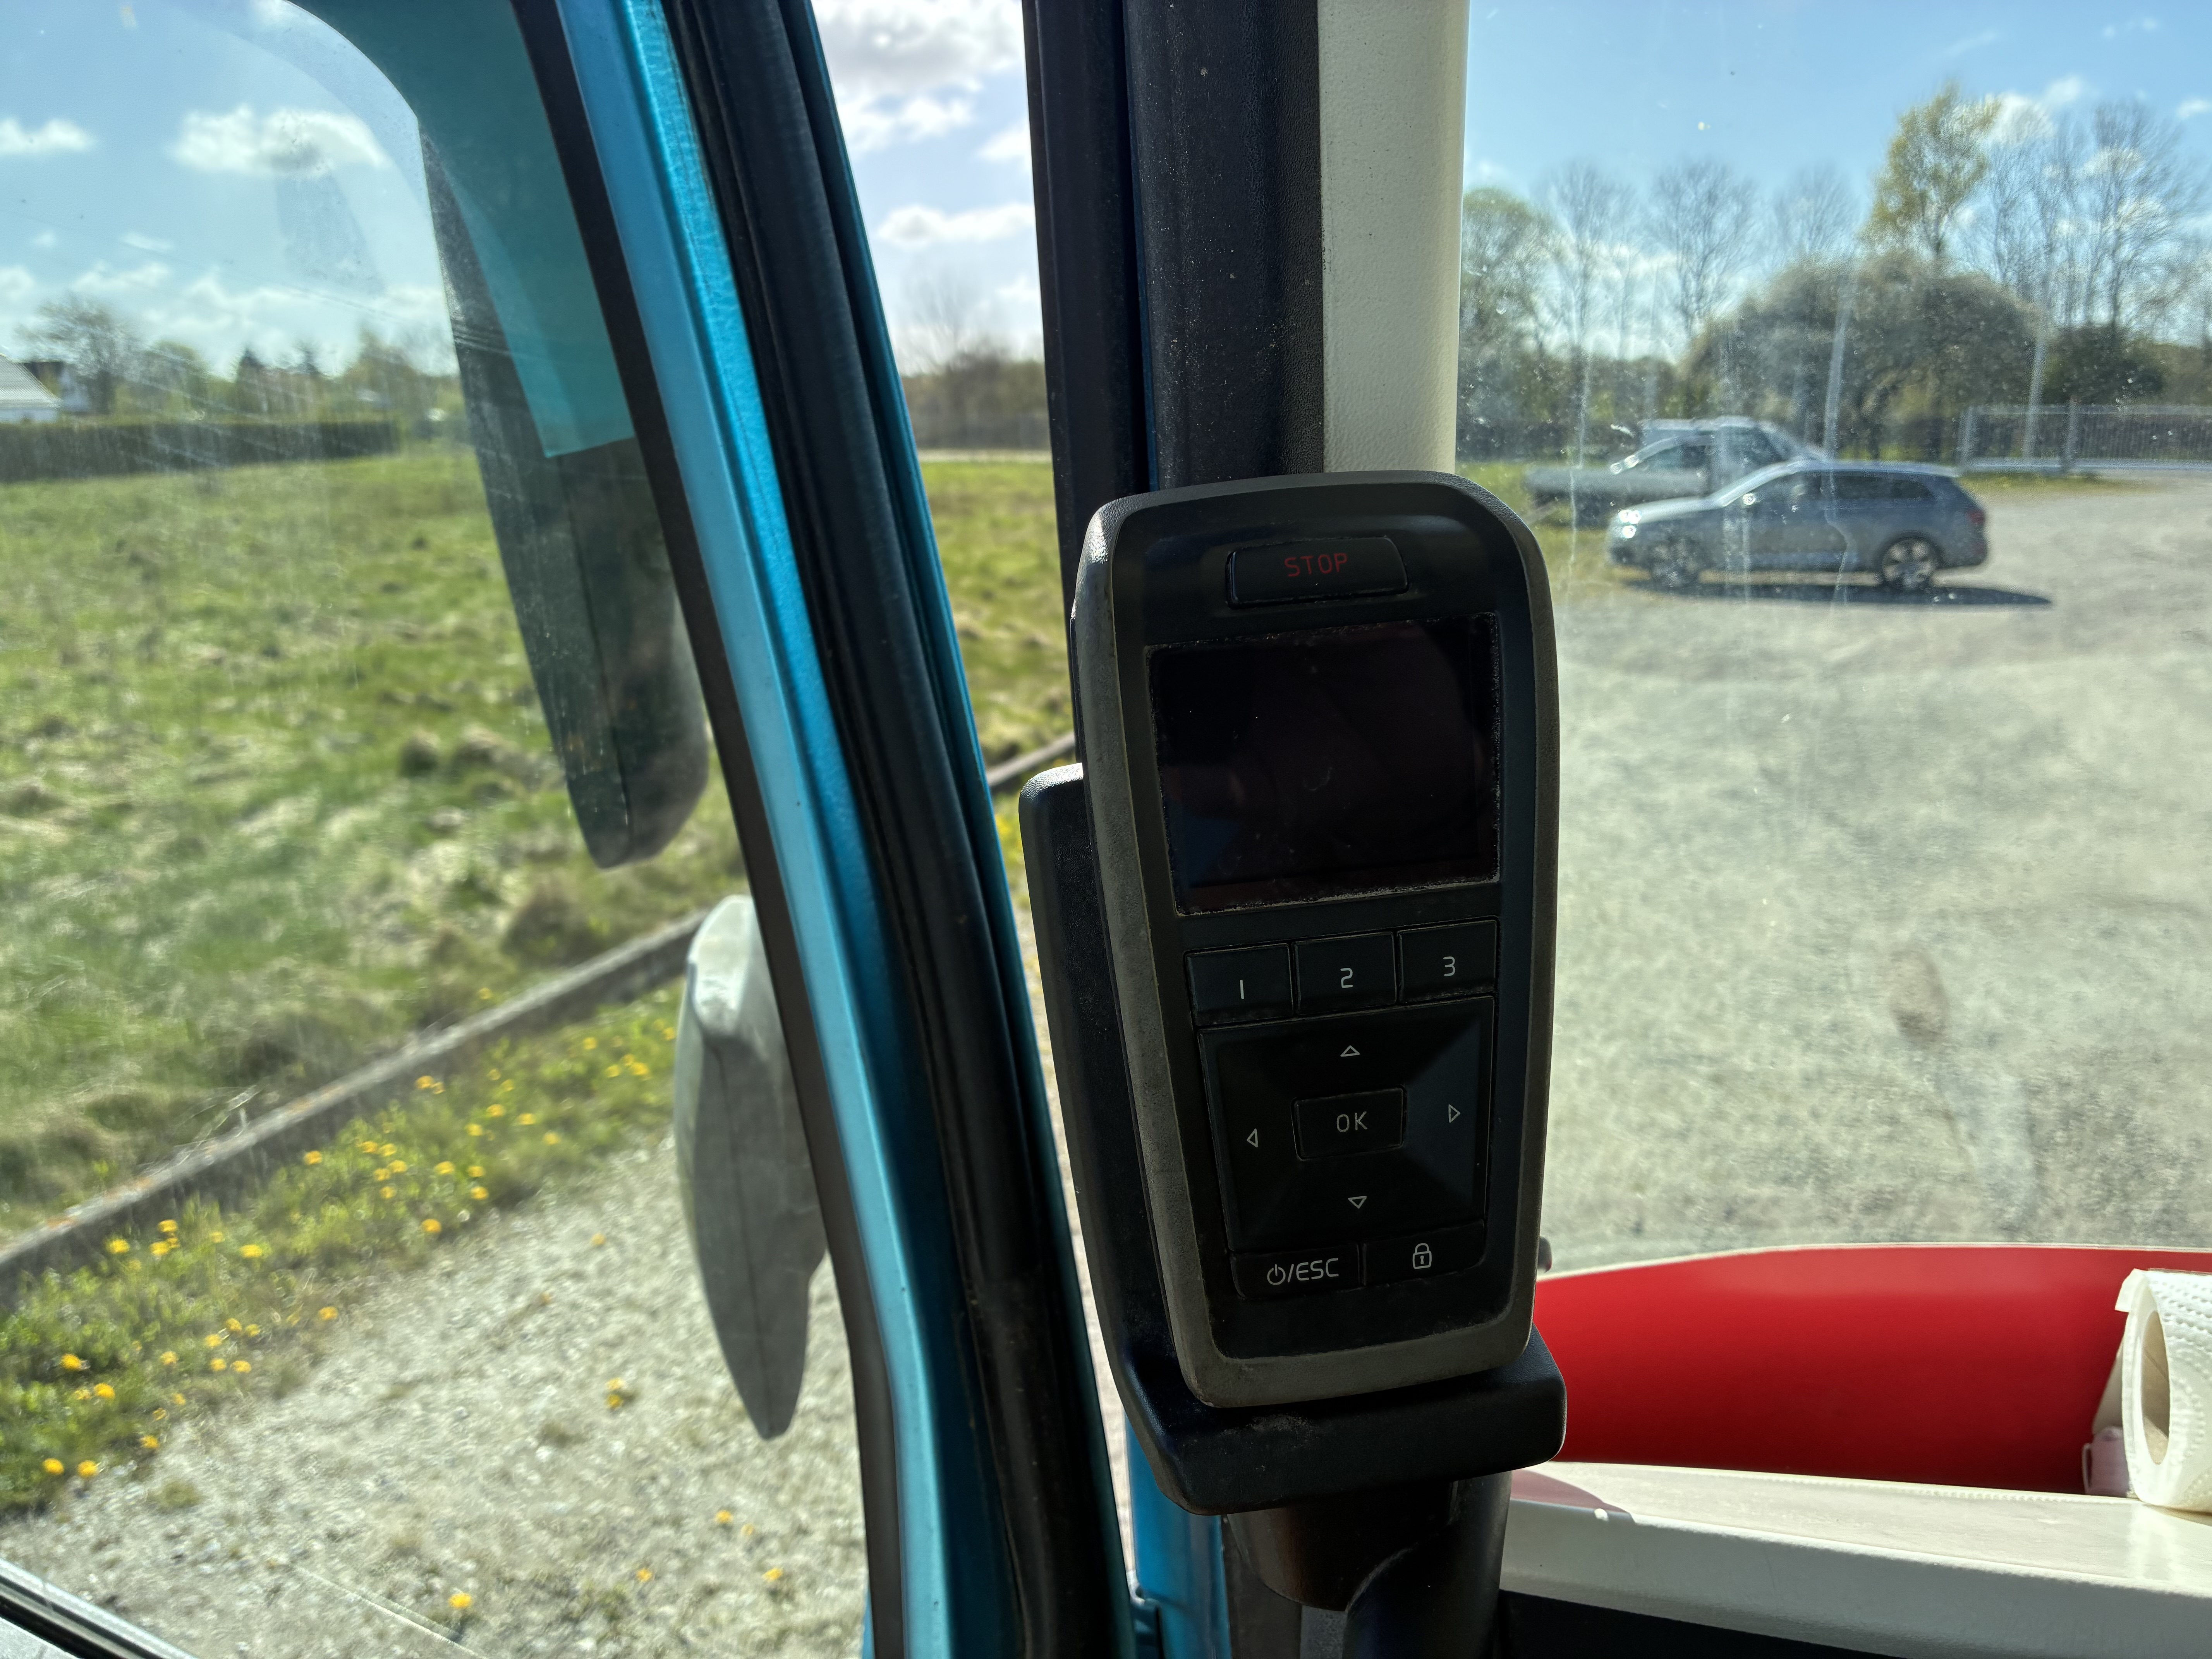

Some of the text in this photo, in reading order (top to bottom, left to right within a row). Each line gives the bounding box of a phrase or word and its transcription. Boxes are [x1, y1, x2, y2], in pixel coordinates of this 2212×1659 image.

[1284, 553, 1348, 577] STOP
[1443, 956, 1456, 977] 3
[1340, 967, 1353, 988] 2
[1239, 979, 1244, 1000] 1
[1336, 1111, 1368, 1132] OK
